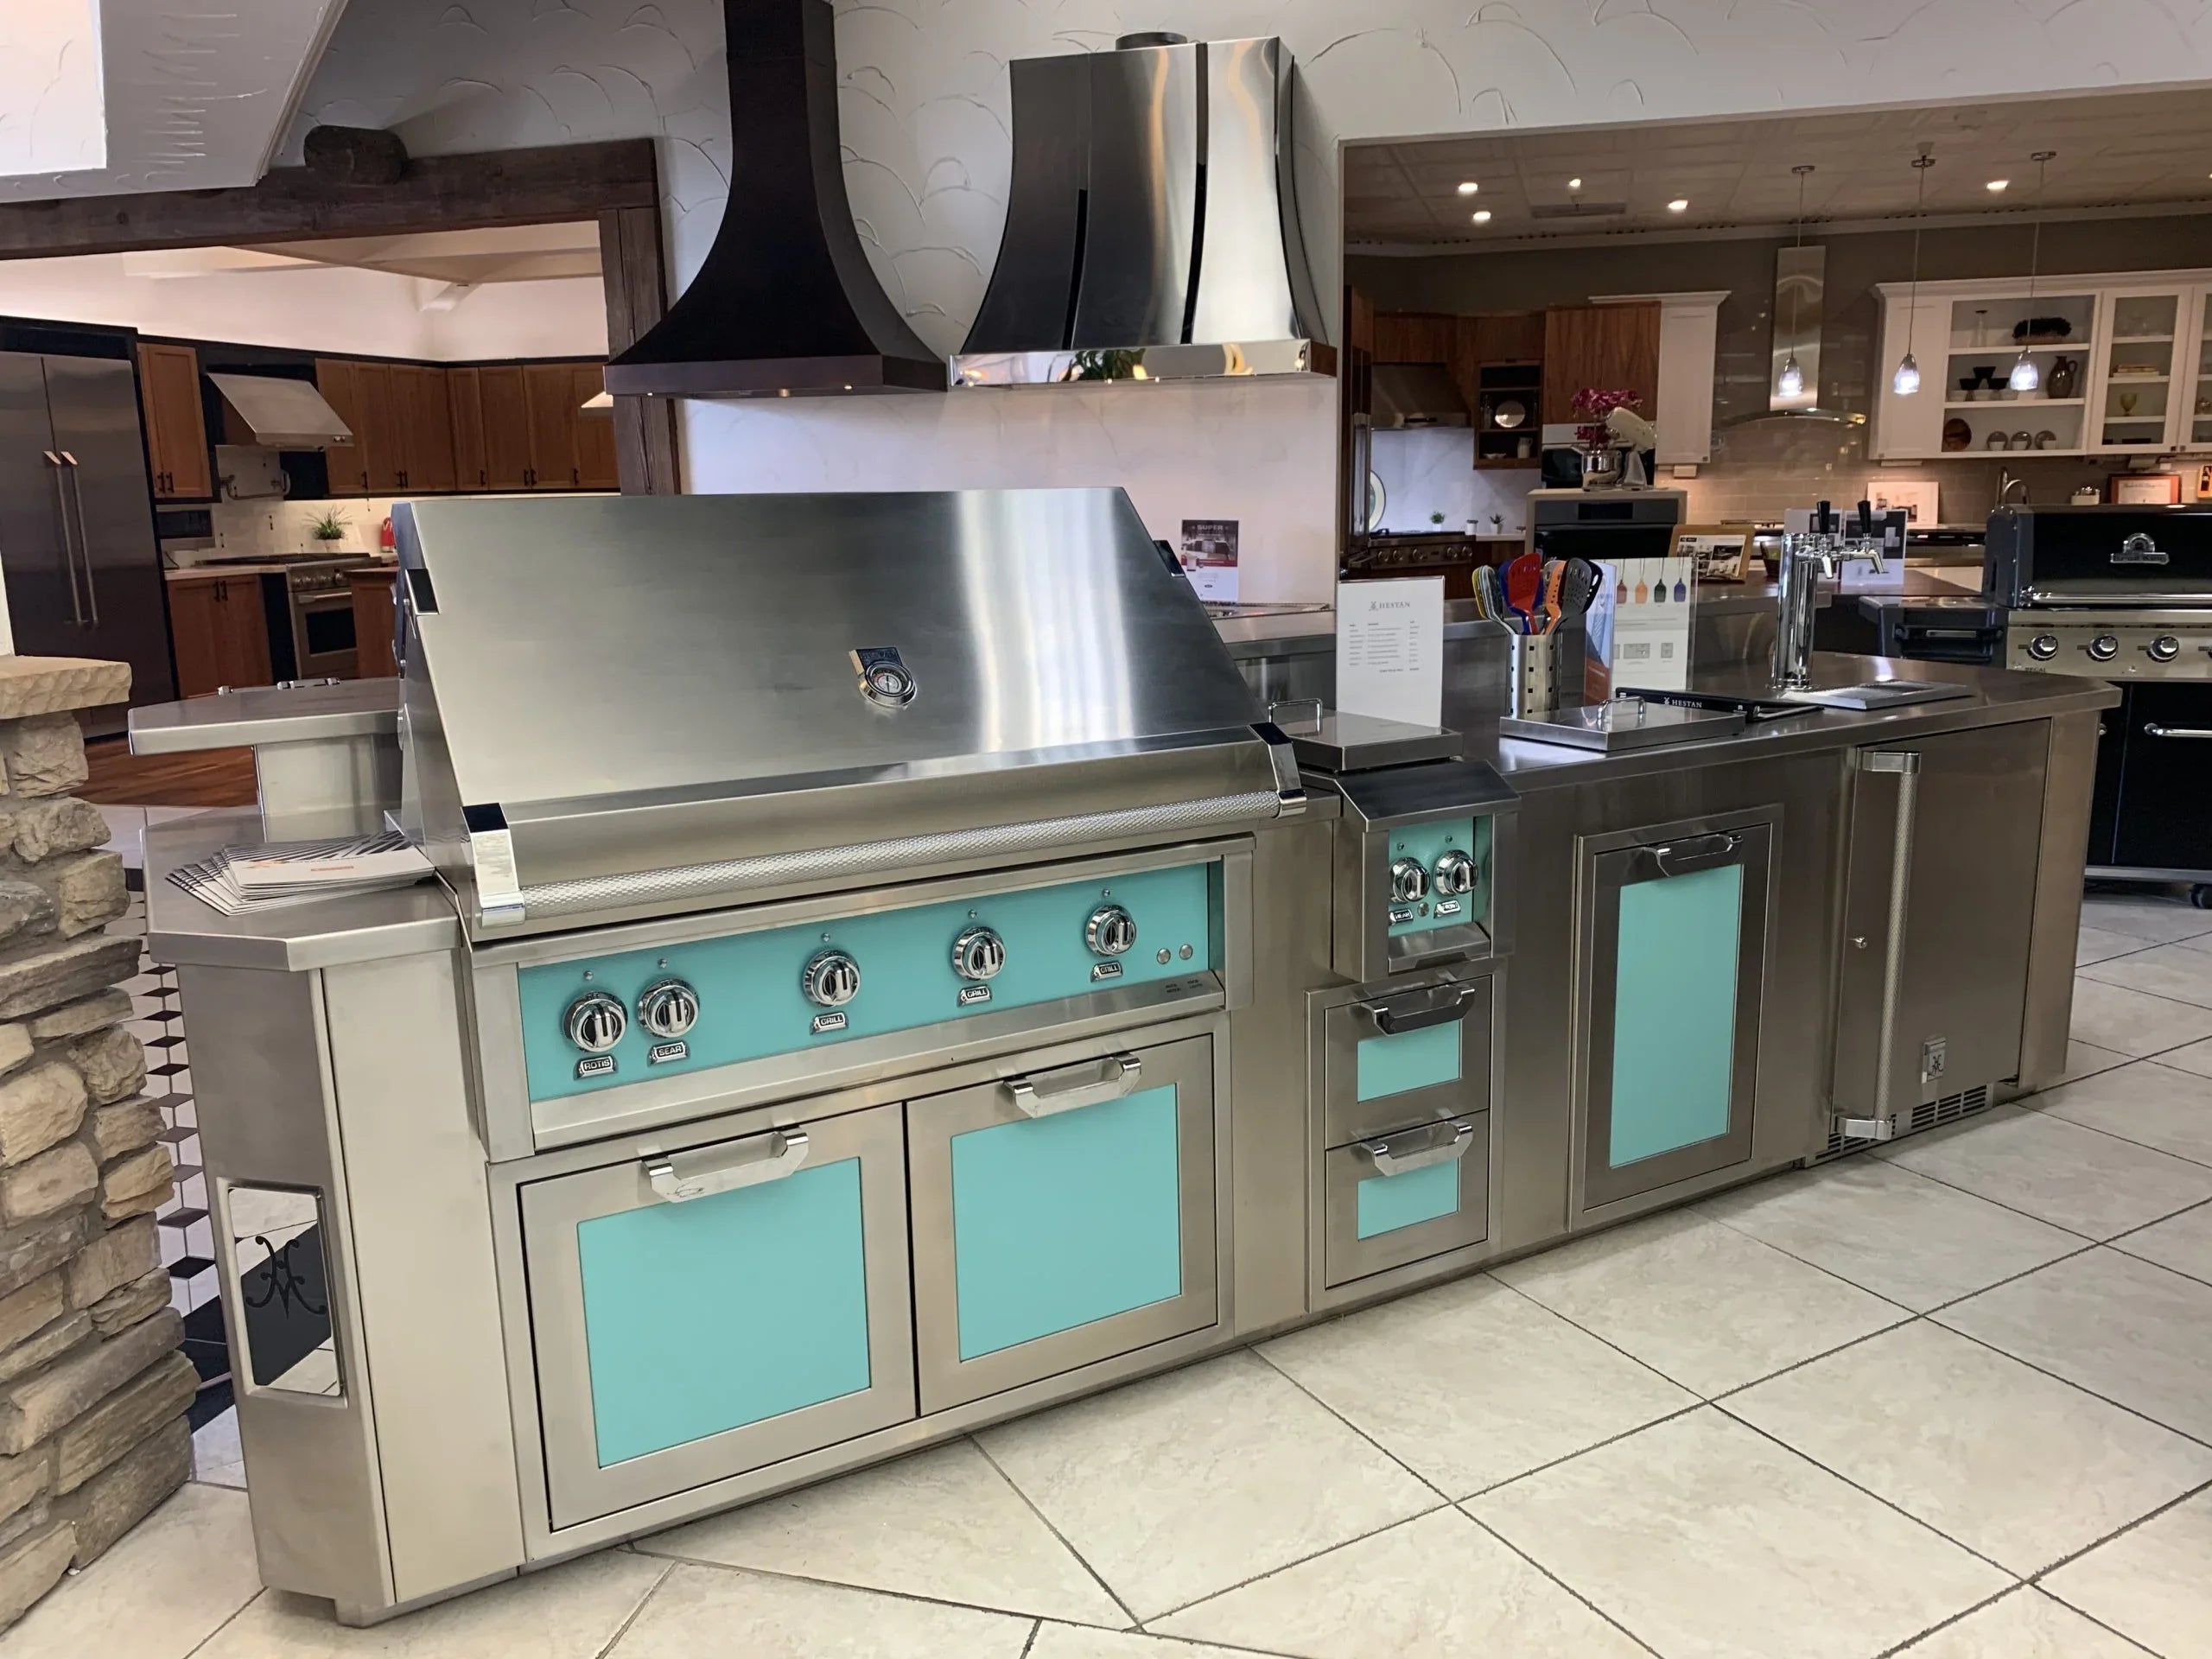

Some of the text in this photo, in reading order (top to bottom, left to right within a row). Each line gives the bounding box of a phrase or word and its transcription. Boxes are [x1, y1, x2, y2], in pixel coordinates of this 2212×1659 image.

[1672, 699, 1702, 709] HESTAN
[1100, 964, 1119, 974] GRILL
[967, 988, 987, 998] GRILL
[820, 1015, 843, 1026] GRILL
[658, 1045, 682, 1056] SEAR
[583, 1058, 610, 1071] ROTIS
